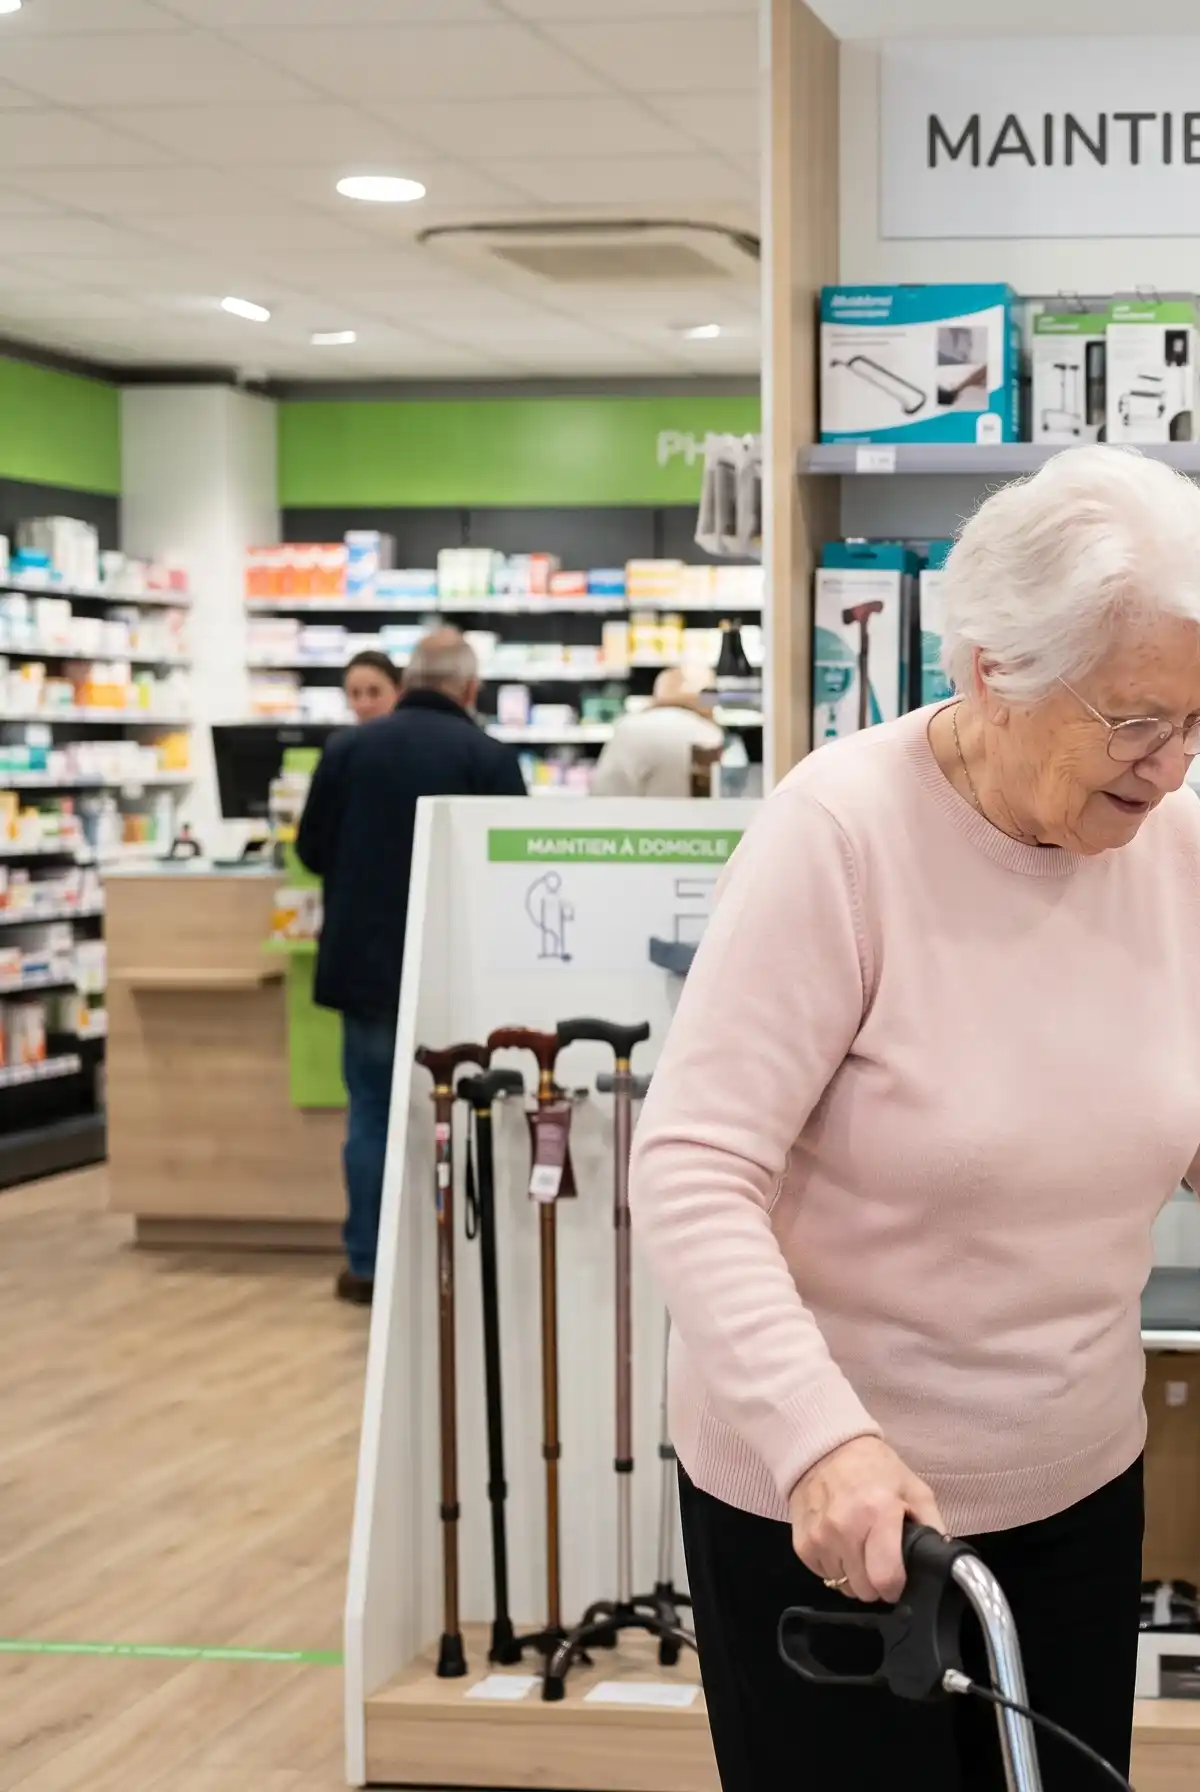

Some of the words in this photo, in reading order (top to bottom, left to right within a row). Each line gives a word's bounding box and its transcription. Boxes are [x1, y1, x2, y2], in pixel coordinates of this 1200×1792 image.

[526, 837, 617, 856] MAINTIEN
[620, 834, 635, 856] À
[638, 838, 730, 858] DOMICILE
